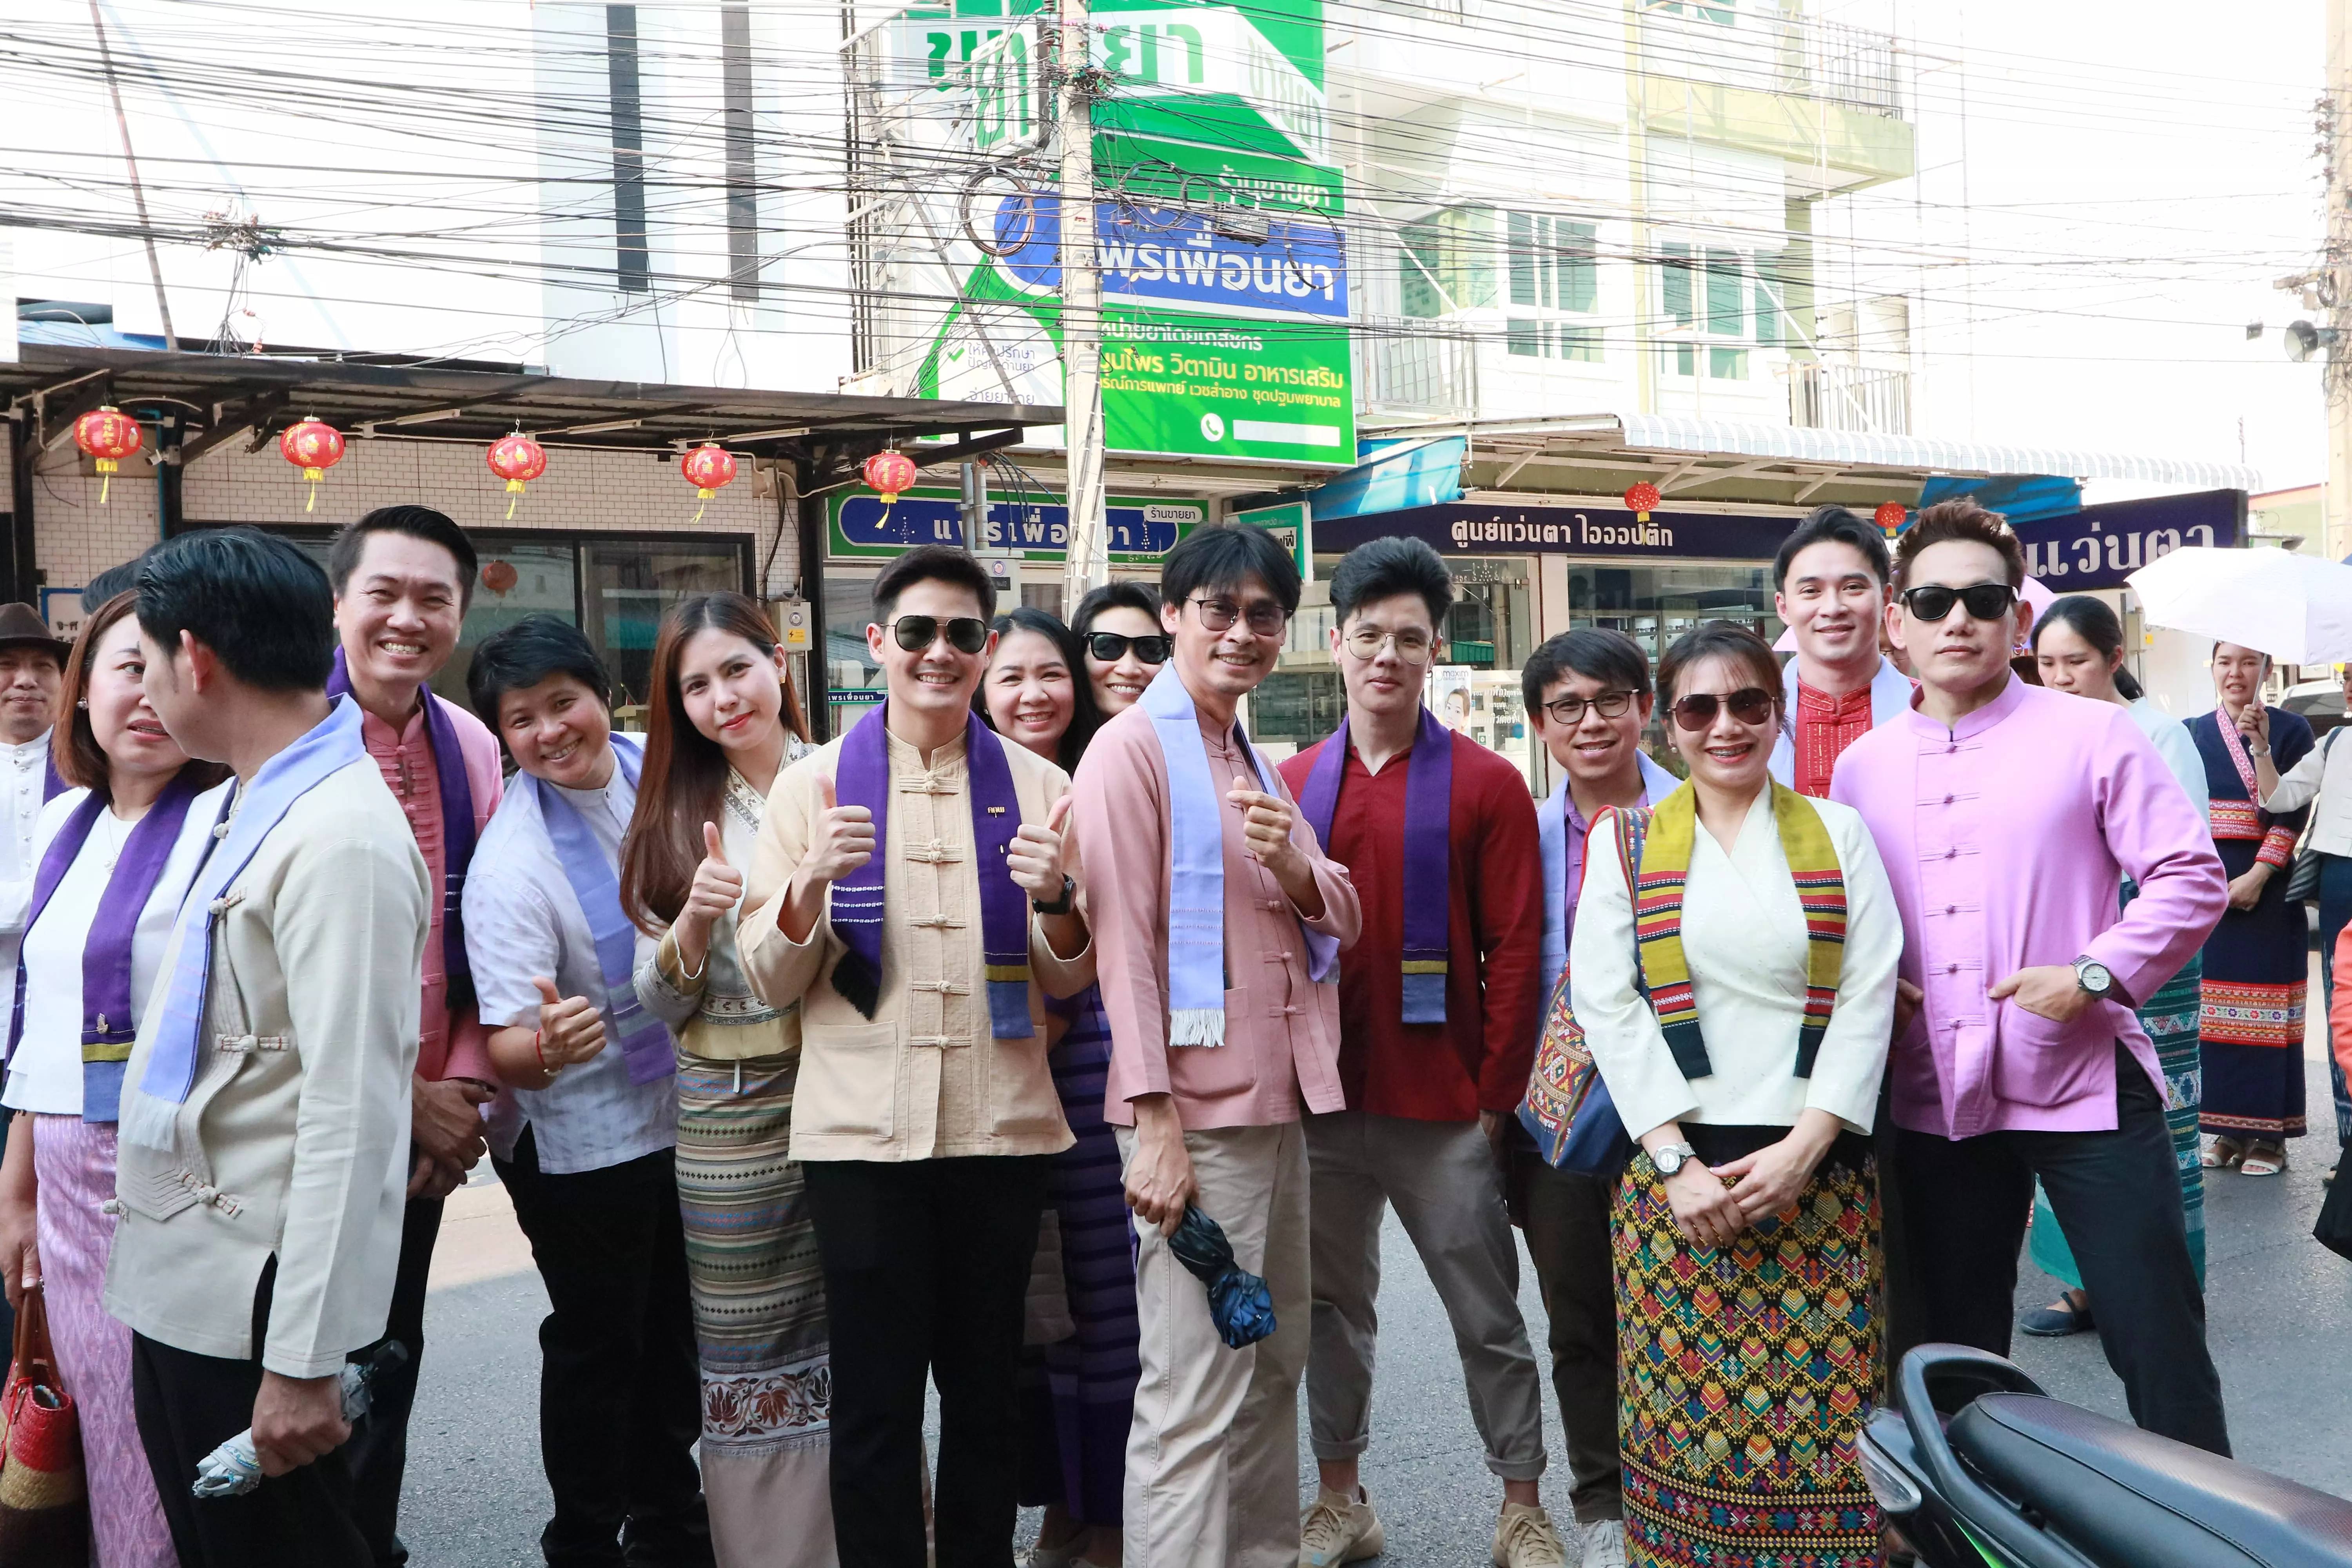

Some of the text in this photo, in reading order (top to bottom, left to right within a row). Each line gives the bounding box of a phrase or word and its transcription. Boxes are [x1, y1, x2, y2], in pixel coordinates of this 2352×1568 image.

[1218, 164, 1330, 207] ร้านขายยา
[1170, 353, 1236, 379] วิตามิน
[1244, 366, 1343, 388] อาหารเสริม
[1189, 381, 1248, 399] เวชสำอาง
[1252, 389, 1341, 408] ชุดปฐมพยาบาล
[1151, 506, 1196, 519] ร้านขายยา
[1451, 514, 1673, 548] ศูนย์แว่นตา ไอออปติก
[2025, 521, 2215, 579] แว่นตา
